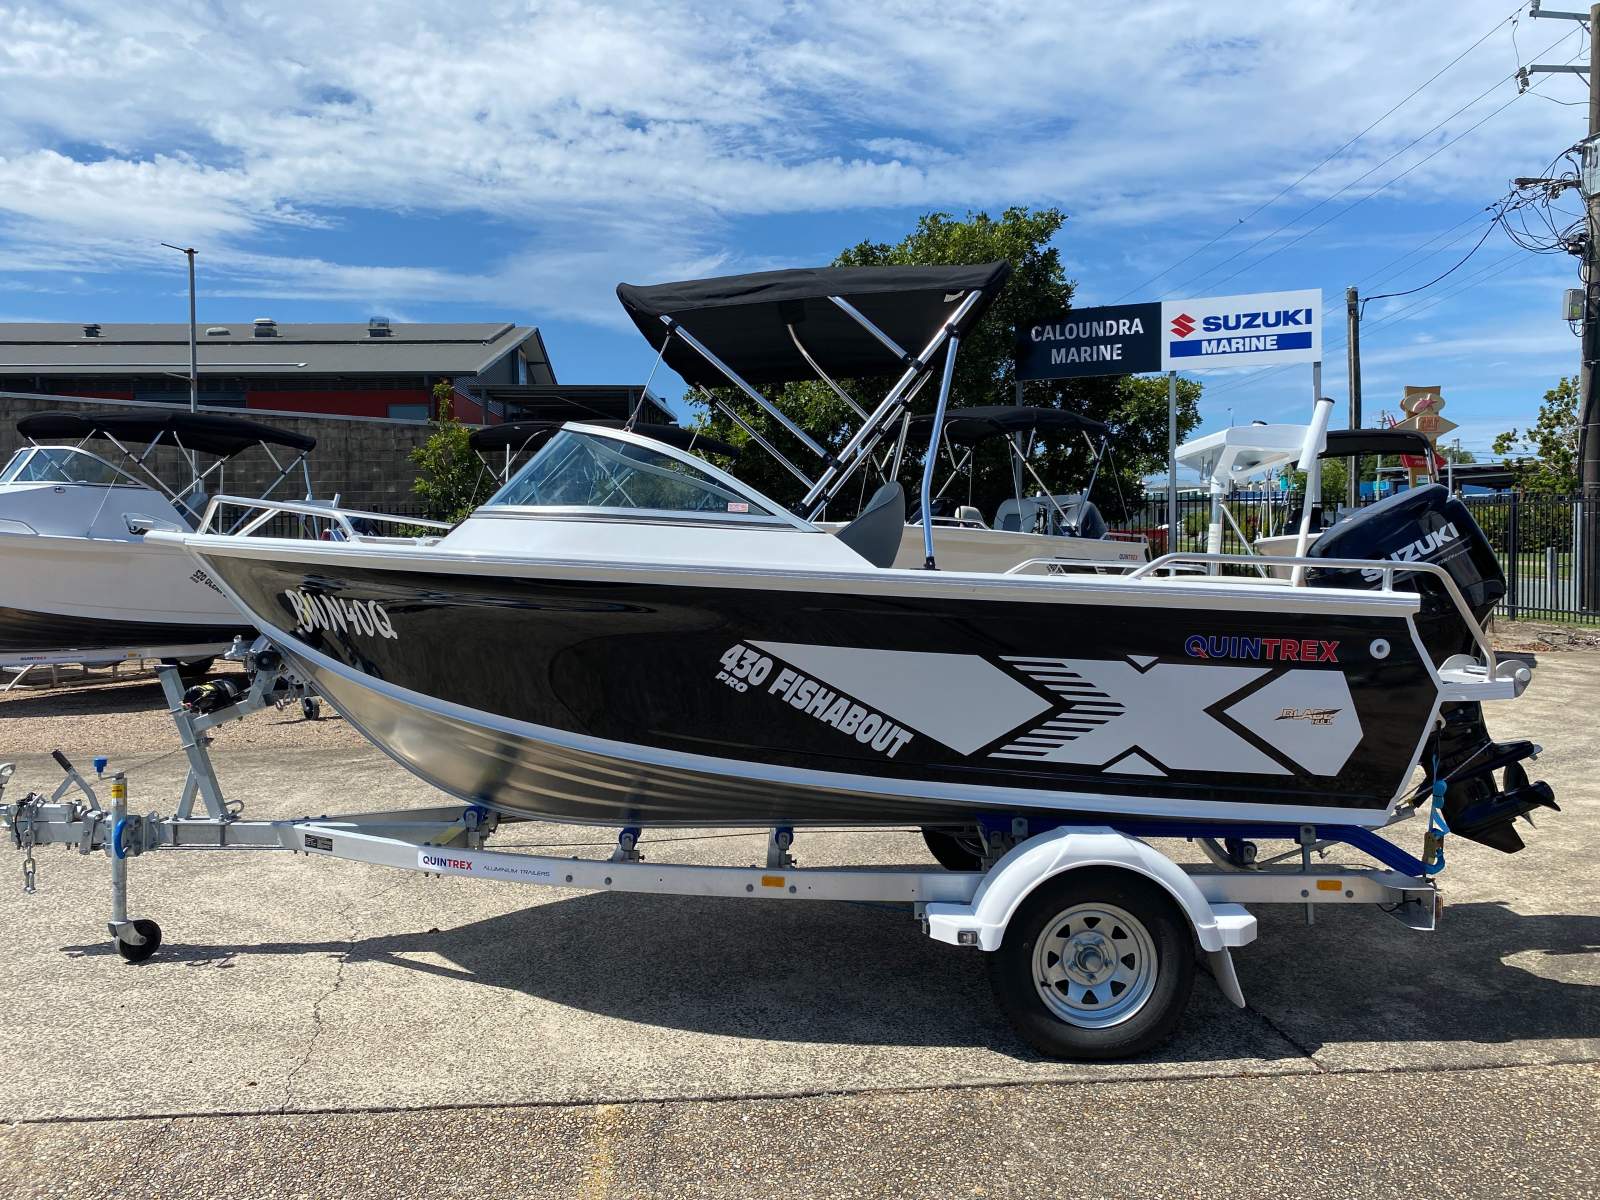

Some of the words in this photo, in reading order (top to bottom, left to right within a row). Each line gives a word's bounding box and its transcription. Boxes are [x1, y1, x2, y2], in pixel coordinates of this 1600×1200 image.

[1031, 318, 1144, 342] CALOUNDRA
[1202, 308, 1313, 333] SUZUKI
[1051, 343, 1123, 365] MARINE
[1201, 335, 1278, 355] MARINE
[1184, 634, 1340, 663] QUINTREX
[715, 671, 749, 693] PRO
[719, 643, 774, 687] 430
[767, 667, 914, 759] FISHABOUT
[1278, 707, 1340, 719] BLADE
[422, 855, 473, 871] QUINTREX
[482, 865, 518, 874] ALUMINIUM
[519, 869, 551, 877] TRAILERS
